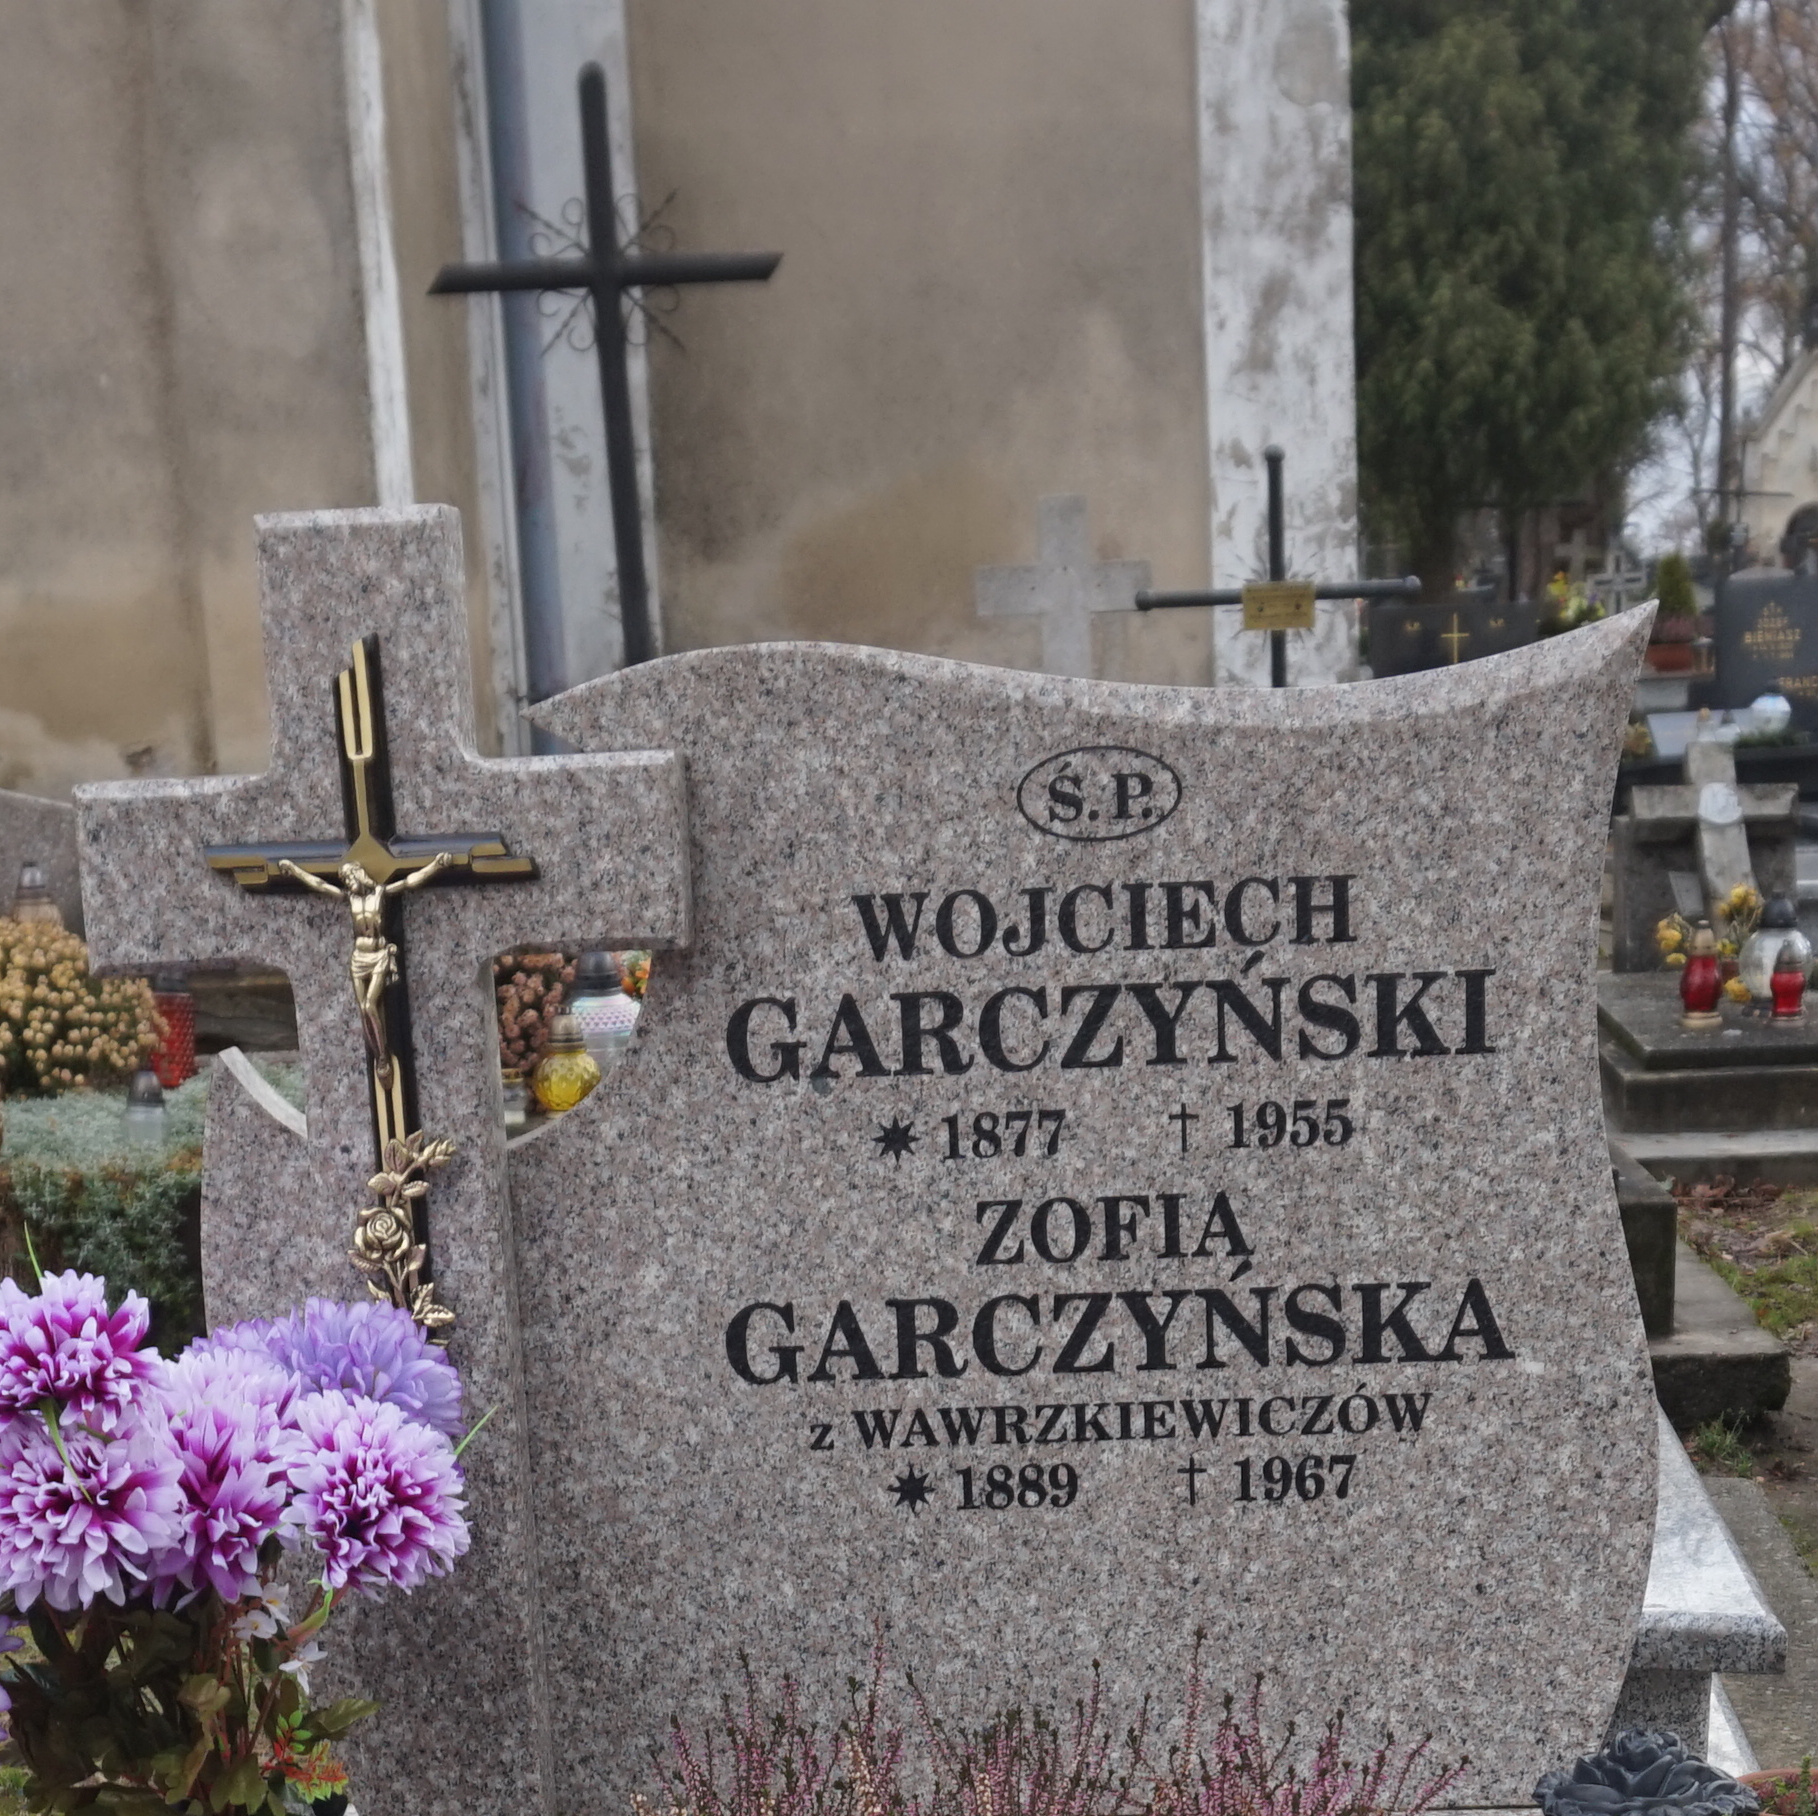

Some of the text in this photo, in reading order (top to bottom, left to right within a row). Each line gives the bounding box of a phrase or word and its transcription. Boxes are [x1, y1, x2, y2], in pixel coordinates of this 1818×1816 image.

[853, 873, 1359, 962] WOJCIECH
[724, 950, 1497, 1085] GARCZYŃSKI
[940, 1097, 1355, 1162] 1877 1955
[975, 1190, 1255, 1267] ZOFIA
[723, 1260, 1516, 1386] GARCZYŃSKA
[853, 1382, 1434, 1449] WAWRZKIEWICZÓW
[954, 1453, 1358, 1511] 1889 1967
